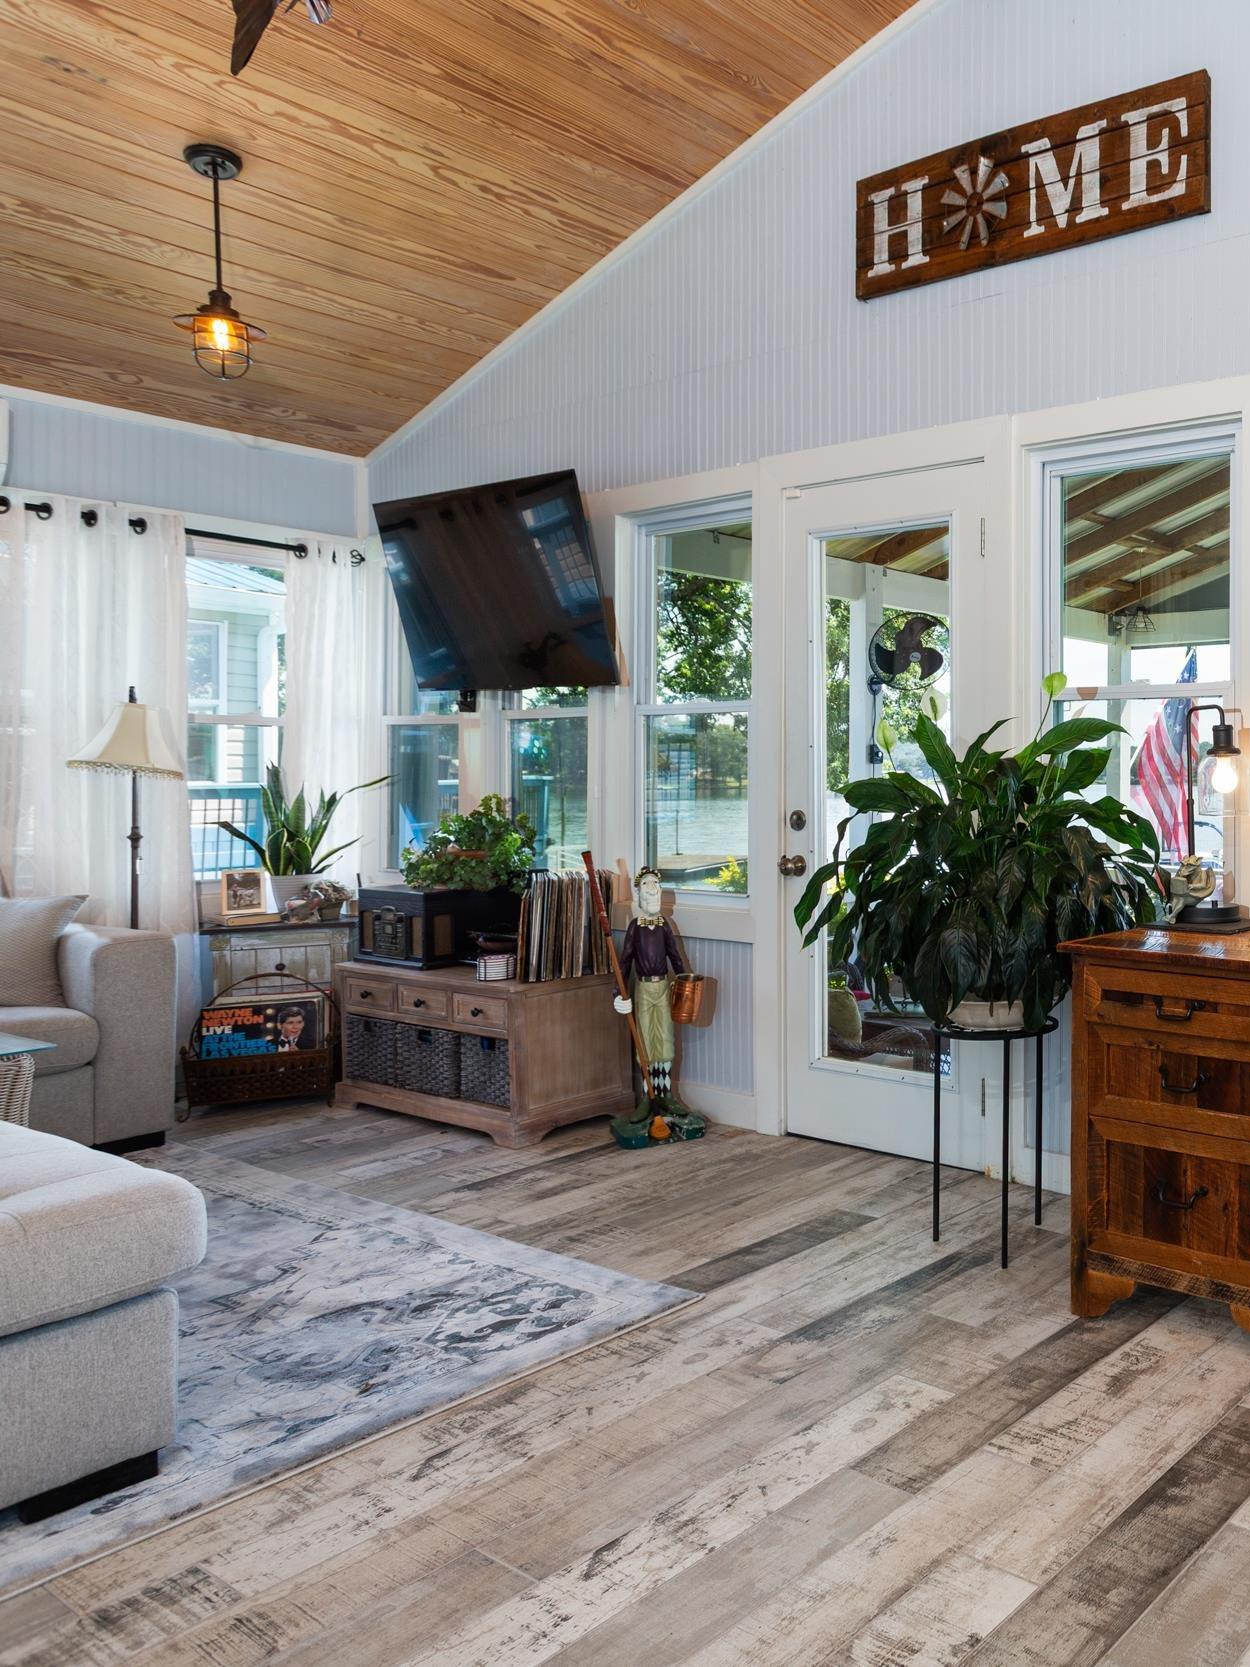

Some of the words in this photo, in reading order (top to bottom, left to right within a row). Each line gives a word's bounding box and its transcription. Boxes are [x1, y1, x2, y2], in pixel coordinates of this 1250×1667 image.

[867, 97, 1188, 278] HME
[202, 1008, 253, 1019] WAYNE
[202, 1015, 264, 1027] NEWTON
[202, 1025, 232, 1036] LIVE
